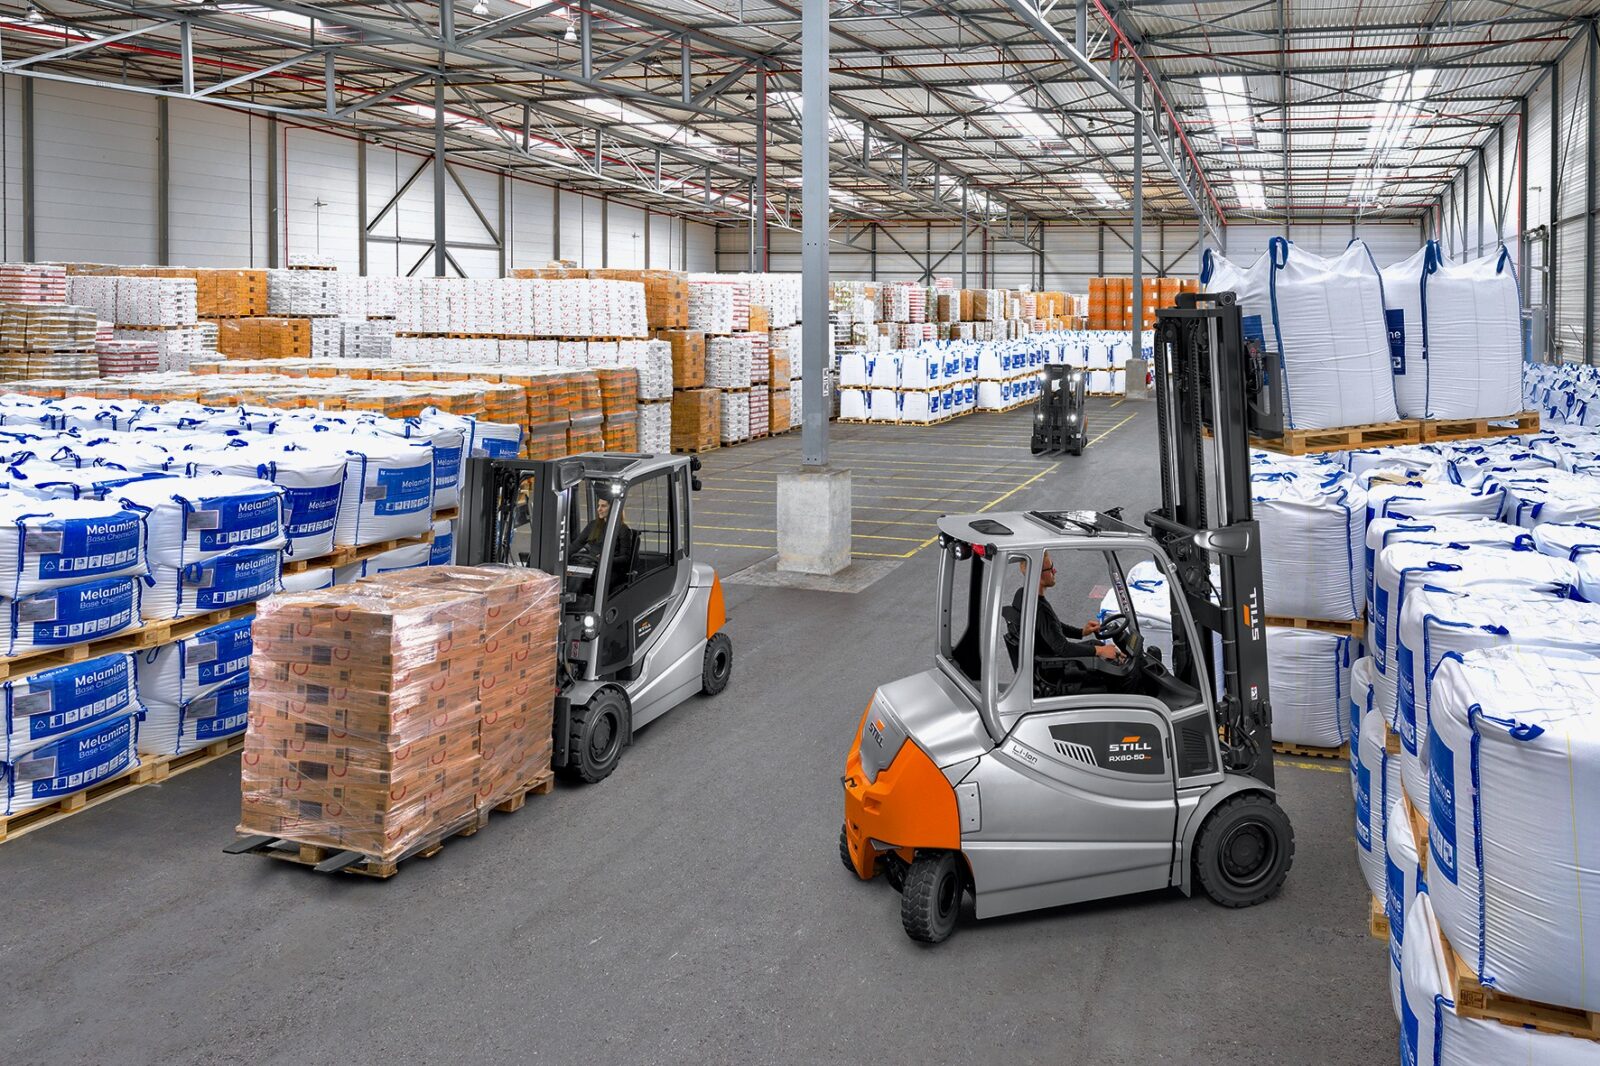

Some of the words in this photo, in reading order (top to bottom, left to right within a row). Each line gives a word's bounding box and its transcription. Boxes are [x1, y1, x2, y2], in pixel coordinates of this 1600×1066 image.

[80, 581, 132, 602] Melamine
[80, 600, 99, 609] Base
[1250, 587, 1260, 641] STILL
[75, 661, 127, 688] Melamine
[75, 684, 95, 695] Base
[79, 723, 129, 752] Melamine
[868, 720, 884, 748] STILL
[79, 747, 98, 759] Base
[1109, 742, 1152, 752] STILL
